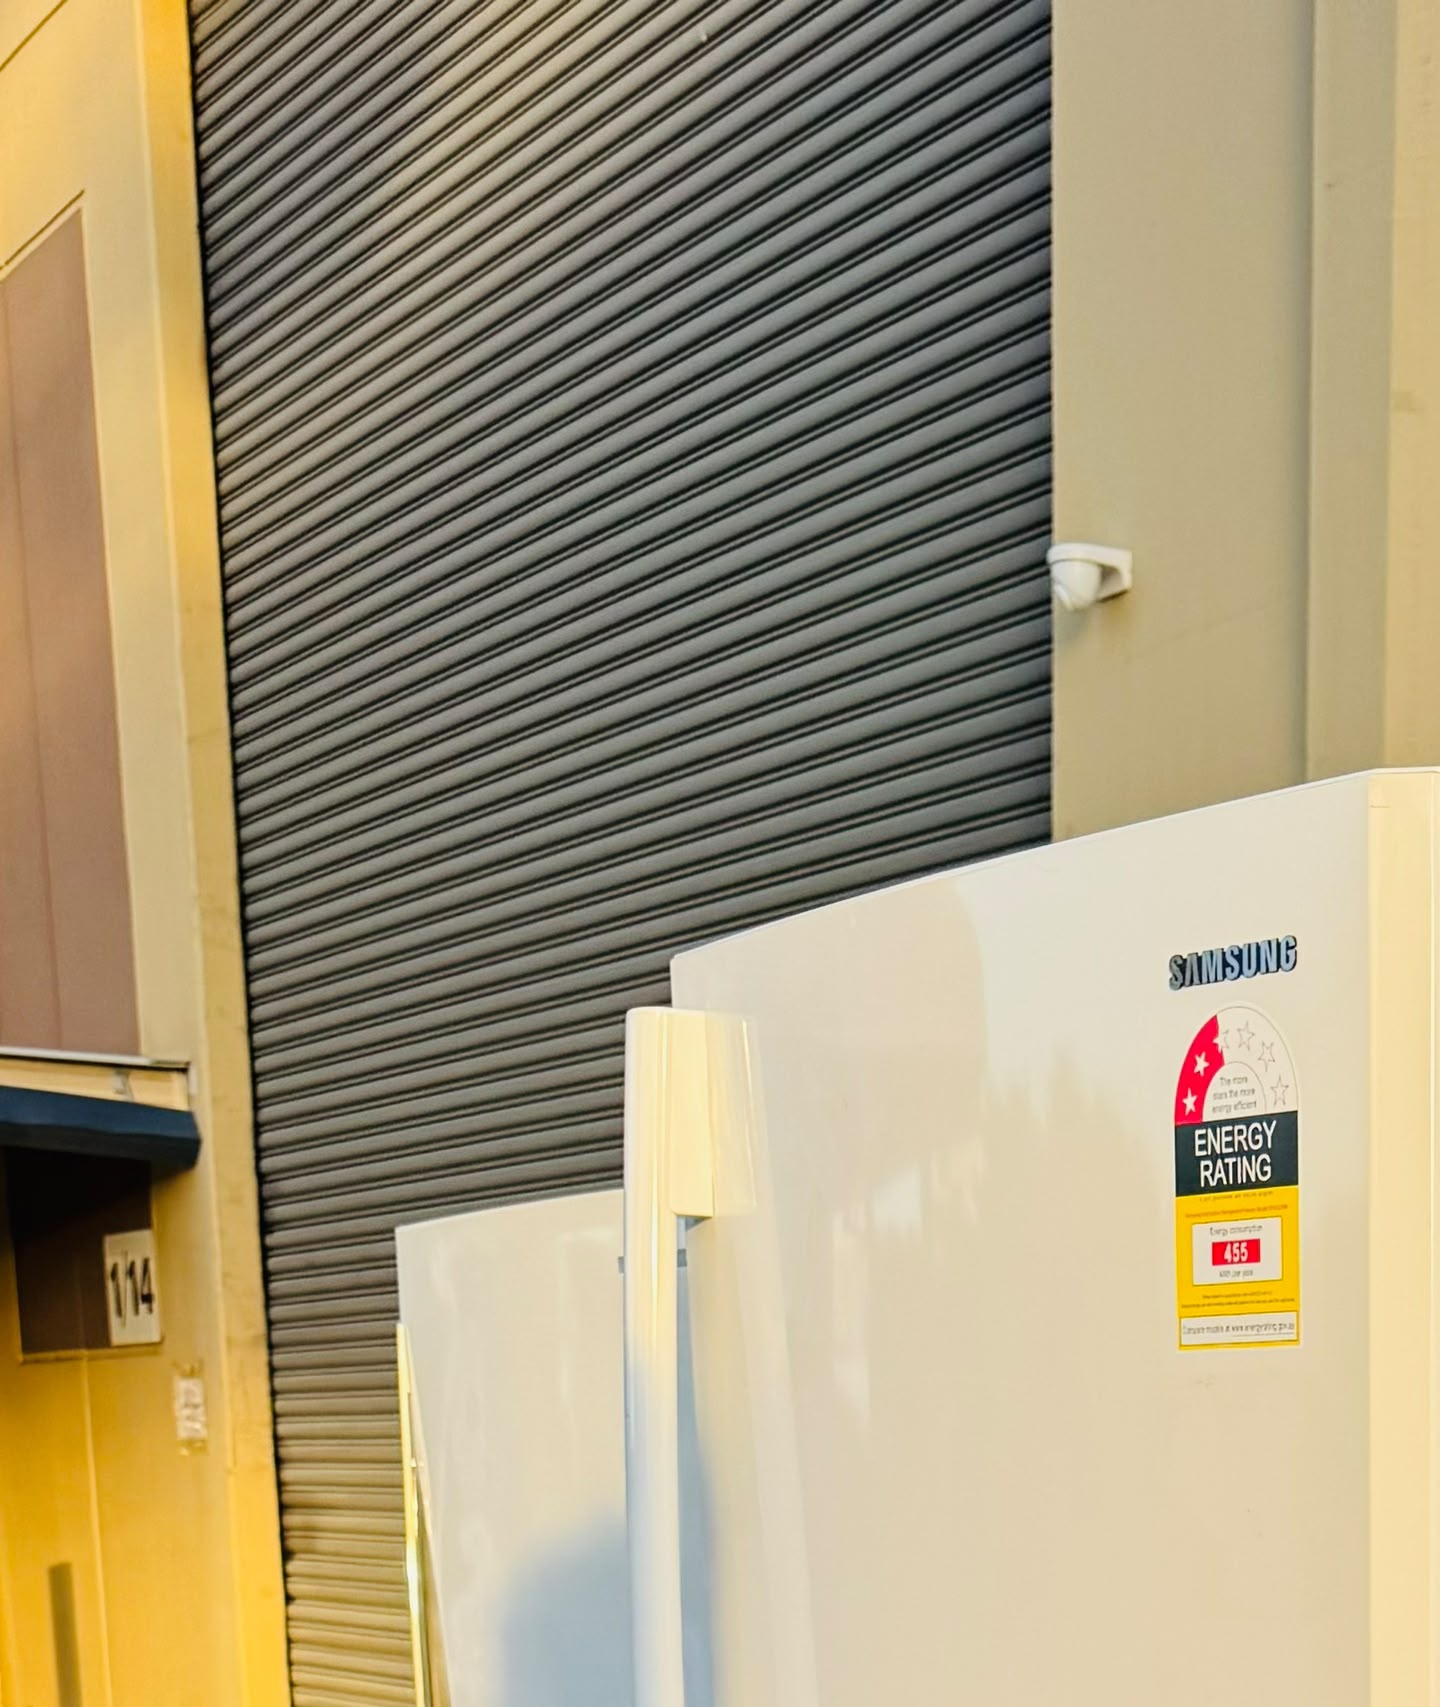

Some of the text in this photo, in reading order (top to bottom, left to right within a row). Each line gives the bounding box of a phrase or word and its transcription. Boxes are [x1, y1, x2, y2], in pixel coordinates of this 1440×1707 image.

[1168, 935, 1297, 990] SAMSUNG
[1194, 1120, 1277, 1156] ENERGY
[1200, 1153, 1271, 1187] RATING
[1223, 1242, 1249, 1263] 455
